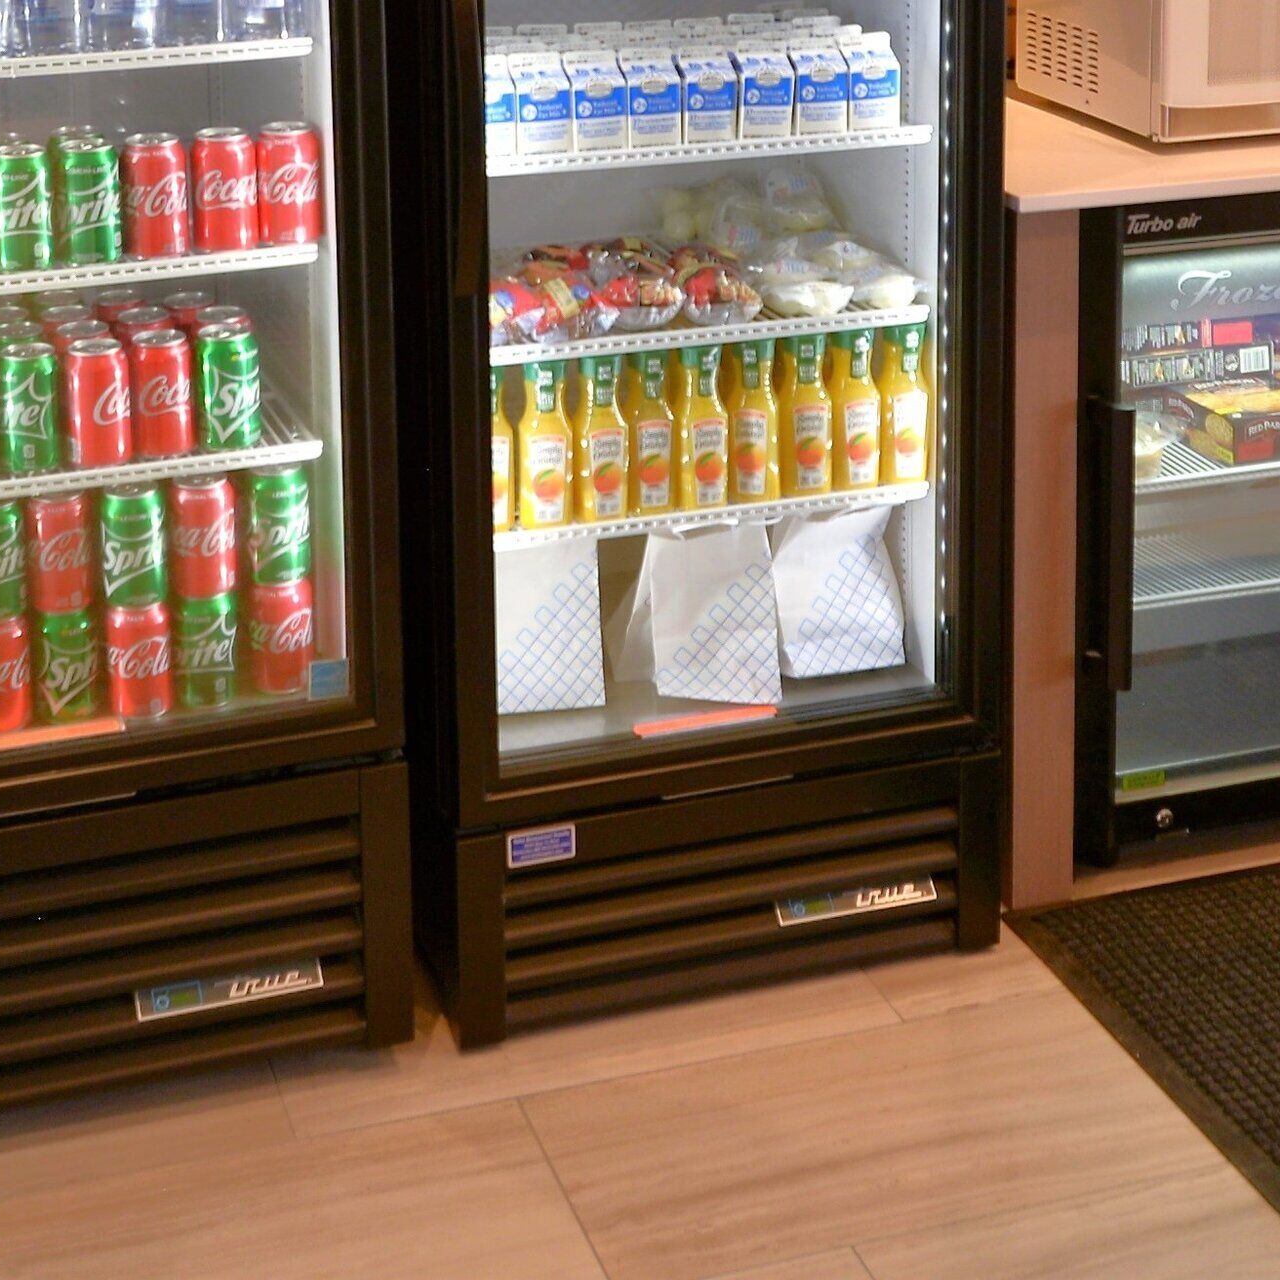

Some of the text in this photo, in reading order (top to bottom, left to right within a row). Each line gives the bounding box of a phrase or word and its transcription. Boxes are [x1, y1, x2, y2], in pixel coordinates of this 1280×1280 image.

[1127, 212, 1202, 234] Turbo air
[1248, 422, 1263, 436] RED
